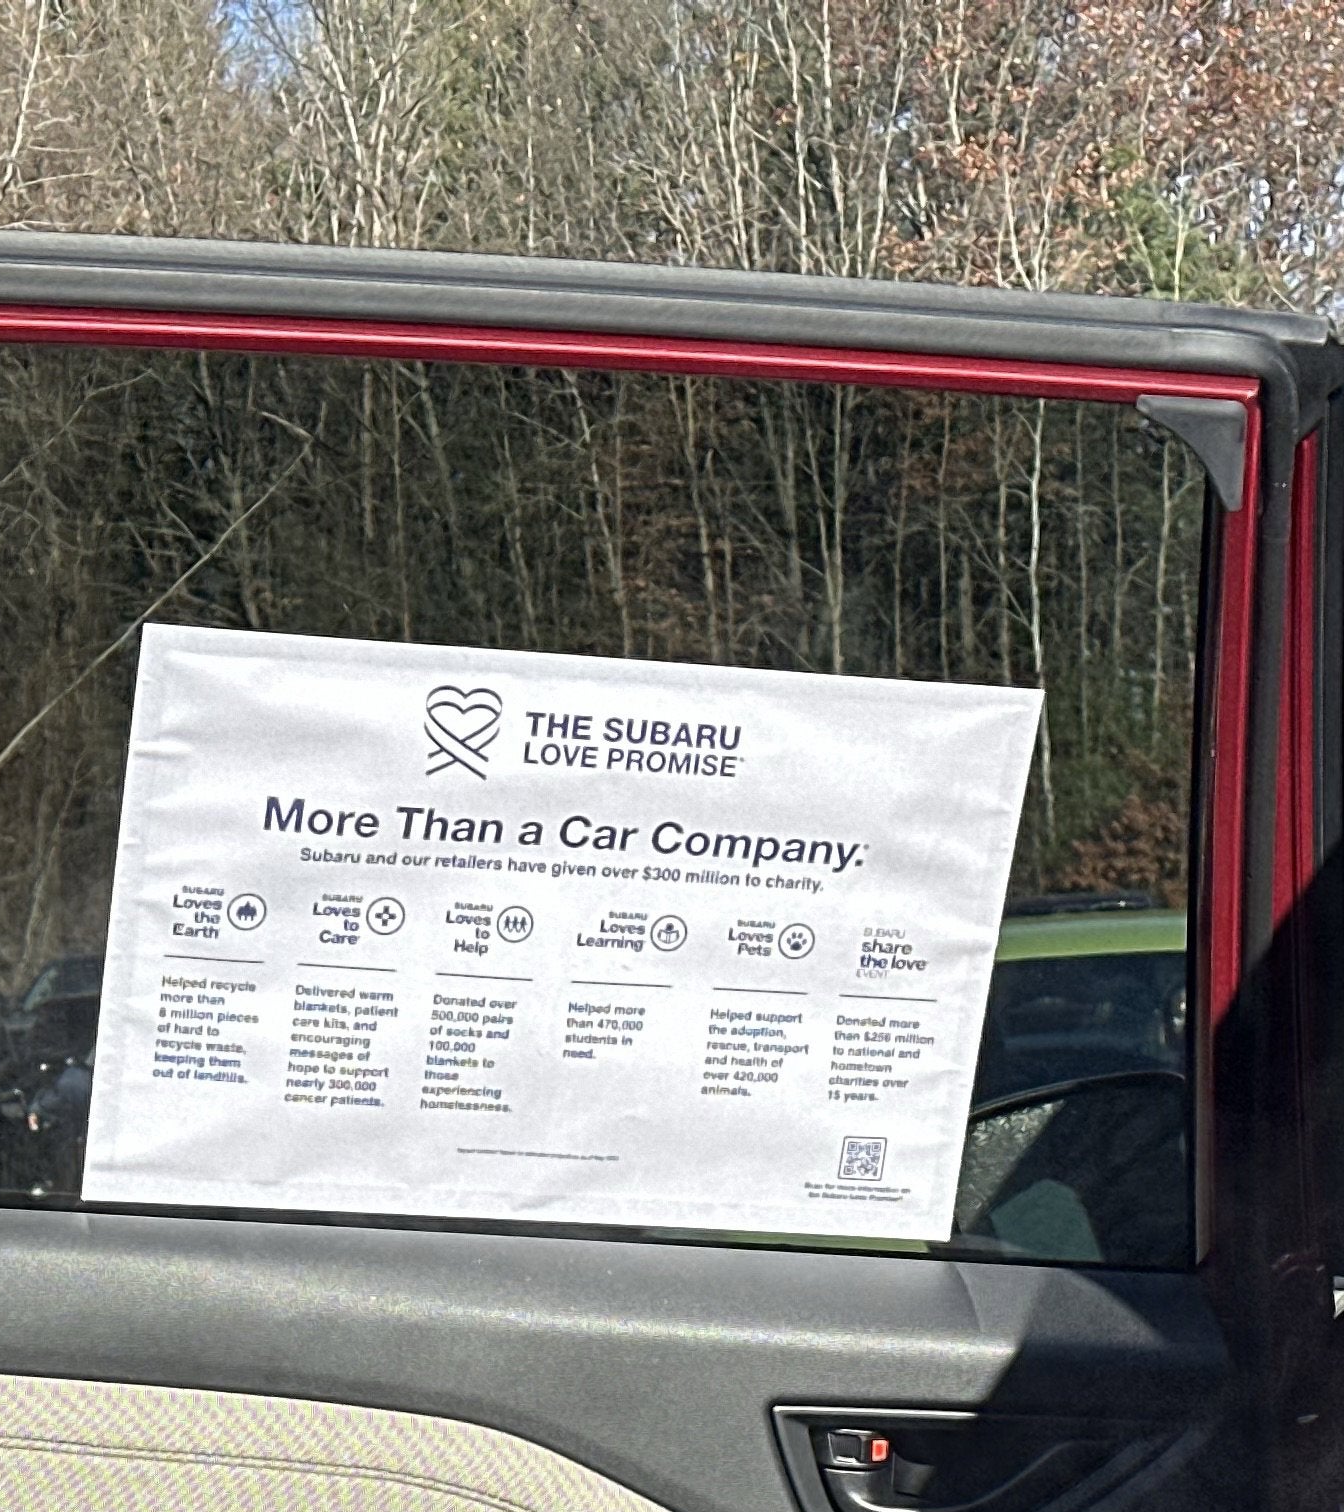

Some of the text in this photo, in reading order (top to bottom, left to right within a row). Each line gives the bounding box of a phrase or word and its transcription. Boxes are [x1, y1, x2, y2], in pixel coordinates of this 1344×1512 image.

[526, 711, 742, 750] THE SUBARU
[523, 742, 737, 777] LOVE PROMISE
[263, 796, 866, 873] More Than a Car Company.
[300, 848, 824, 893] Subaru and our retailers have given over $300 million to charity.
[173, 894, 222, 910] Loves
[313, 902, 361, 917] Loves
[194, 911, 221, 924] the
[446, 911, 491, 926] Loves
[173, 924, 219, 939] Earth
[344, 919, 359, 932] to
[600, 920, 645, 935] Loves
[319, 930, 358, 945] Care
[476, 928, 490, 939] to
[728, 928, 773, 942] Loves
[454, 939, 488, 957] Help
[577, 934, 645, 952] Learning
[738, 943, 771, 957] Pets
[862, 939, 912, 954] share
[860, 954, 927, 970] the love
[162, 975, 257, 993] Helped recycle
[161, 993, 225, 1005] more than
[296, 985, 393, 1001] Delivered warm
[433, 994, 517, 1009] Donated over
[171, 1009, 213, 1020] million
[217, 1012, 259, 1023] pieces
[355, 1006, 399, 1017] patient
[569, 1002, 646, 1016] Helped more
[483, 1014, 513, 1025] pairs
[567, 1018, 593, 1028] than
[711, 1009, 802, 1024] Helped support
[837, 1015, 919, 1029] Donated more
[157, 1023, 219, 1036] of hard to
[292, 1018, 319, 1027] care
[353, 1021, 377, 1031] and
[430, 1025, 509, 1039] of socks and
[709, 1025, 786, 1039] the adoption,
[835, 1031, 860, 1041] than
[895, 1033, 934, 1045] million
[156, 1039, 202, 1051] recycle
[291, 1034, 370, 1048] encouraging
[565, 1034, 633, 1046] students in
[289, 1048, 370, 1061] messages of
[754, 1042, 809, 1055] transport
[833, 1046, 920, 1059] to national and
[155, 1052, 241, 1067] keeping them
[427, 1055, 495, 1068] blankets to
[705, 1056, 783, 1068] and health of
[831, 1061, 892, 1072] hometown
[153, 1068, 174, 1078] out
[177, 1069, 190, 1079] of
[288, 1061, 389, 1078] hope to support
[424, 1070, 459, 1080] those
[703, 1071, 729, 1080] over
[286, 1078, 325, 1091] nearly
[829, 1076, 909, 1088] charities over
[284, 1093, 327, 1103] cancer
[422, 1085, 502, 1099] experiencing
